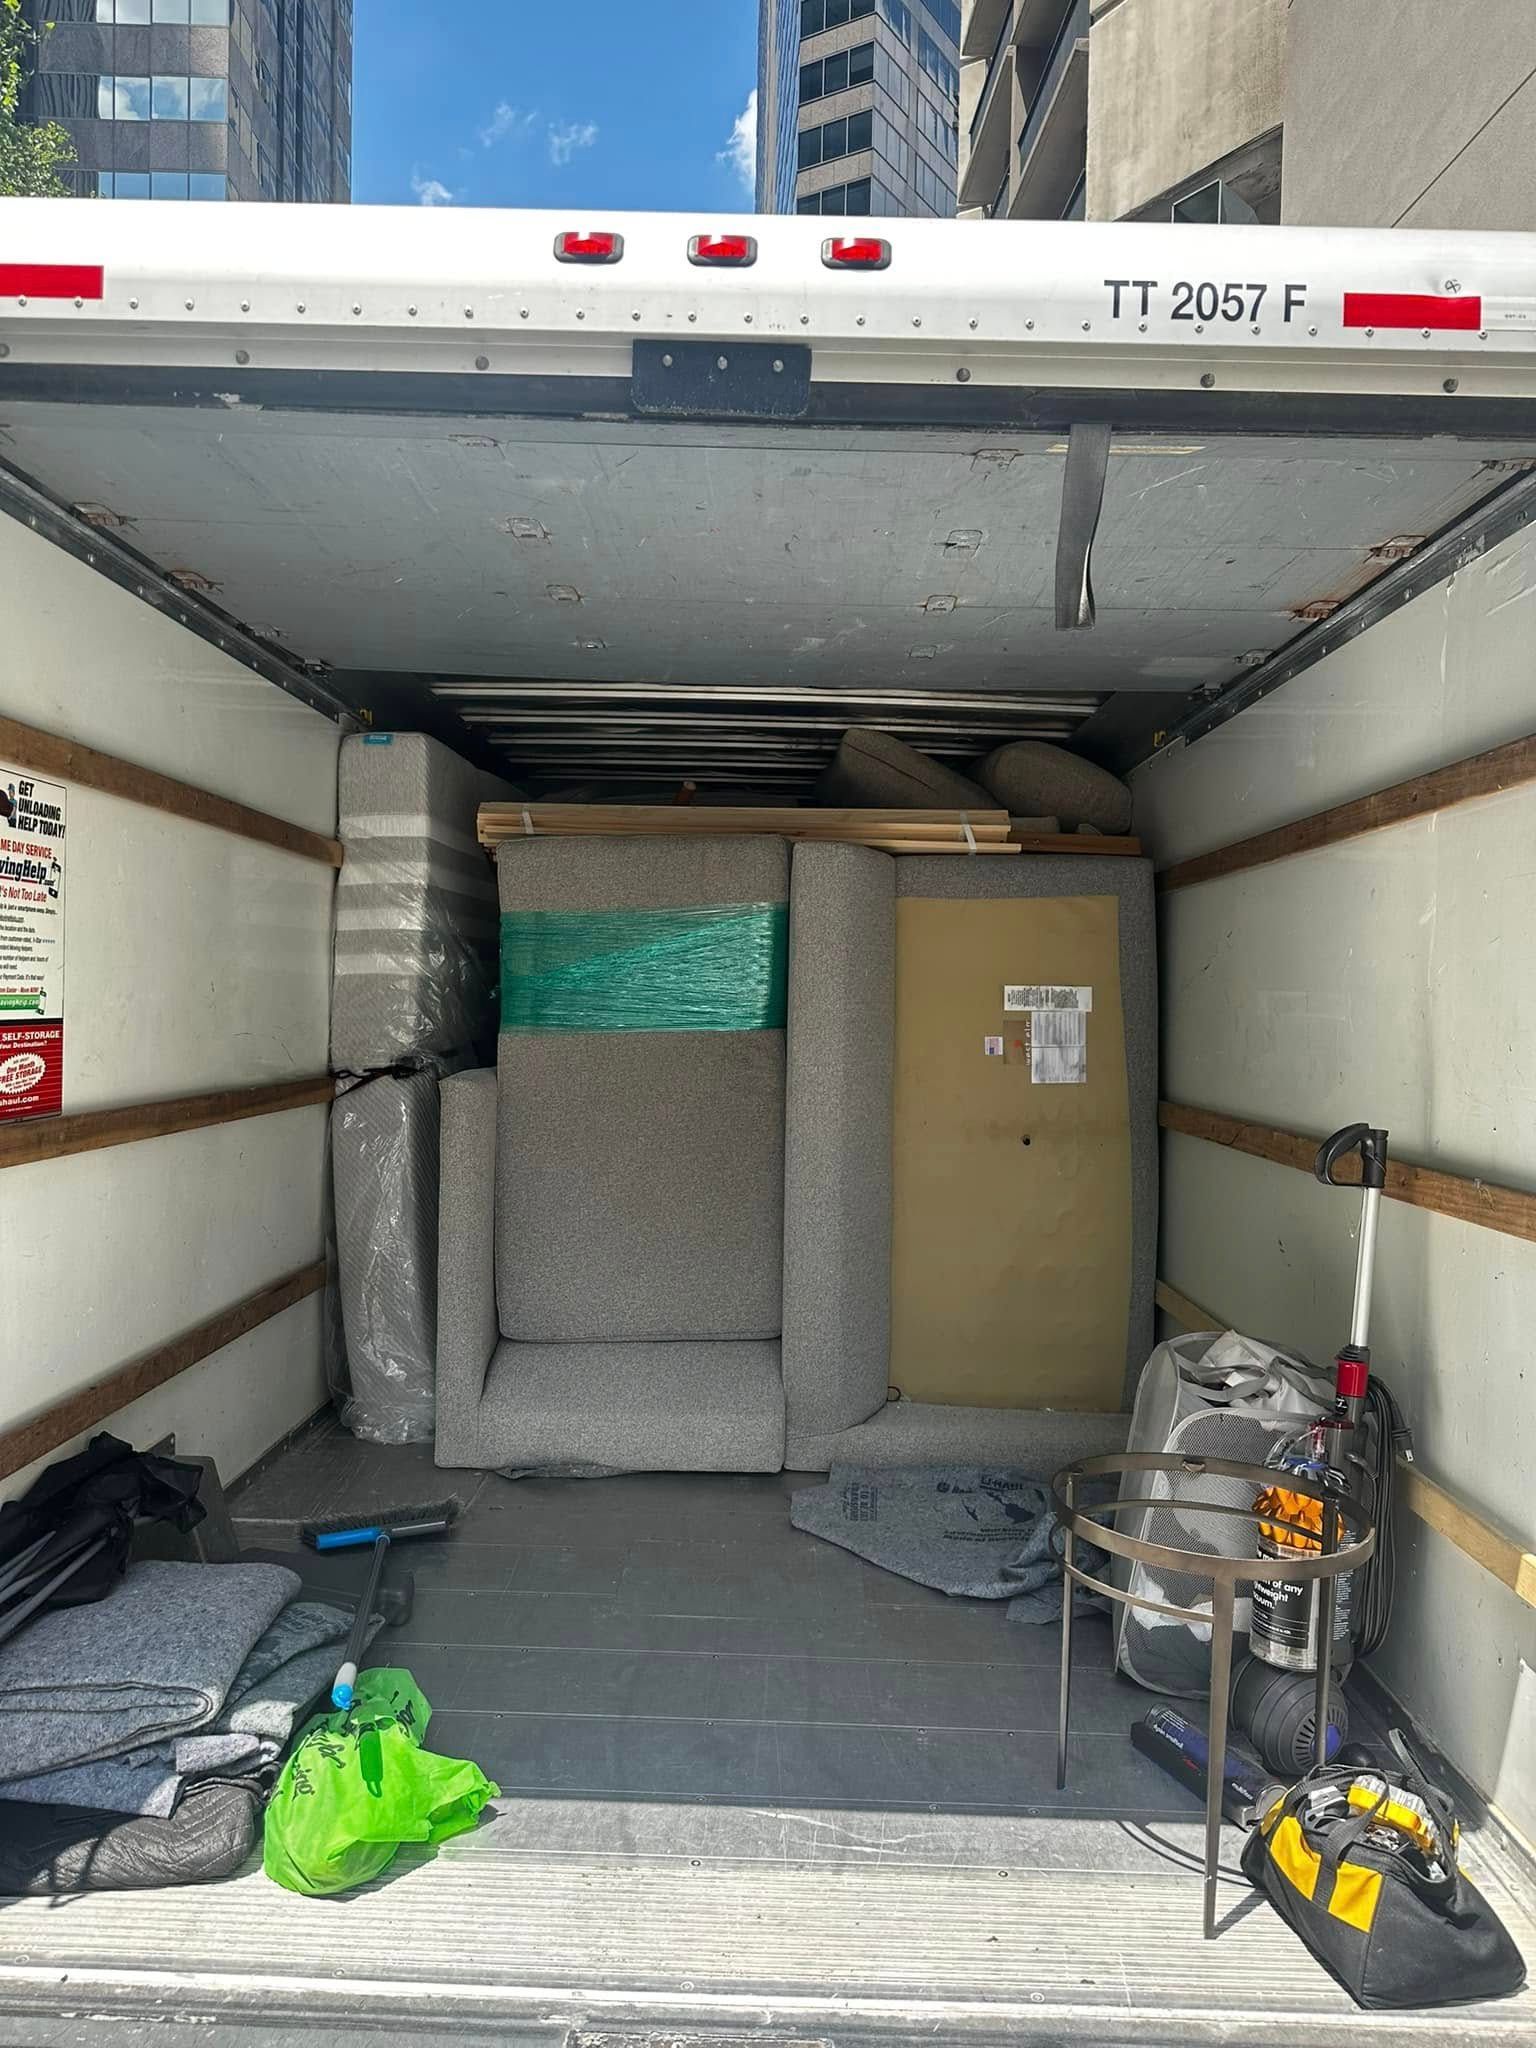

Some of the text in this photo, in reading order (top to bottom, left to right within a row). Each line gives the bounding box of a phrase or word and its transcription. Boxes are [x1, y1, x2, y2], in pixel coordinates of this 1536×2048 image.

[1104, 280, 1307, 323] TT 2057 F
[18, 780, 35, 798] GET
[18, 798, 61, 821] UNLOADING
[17, 815, 66, 839] HELP TODAY!
[12, 841, 25, 855] DAY
[25, 843, 52, 860] SERVICE
[8, 886, 20, 899] Not
[21, 888, 34, 900] Too
[2, 1030, 60, 1041] SELF-STORAGE
[1272, 1580, 1282, 1590] of
[1284, 1584, 1304, 1596] any
